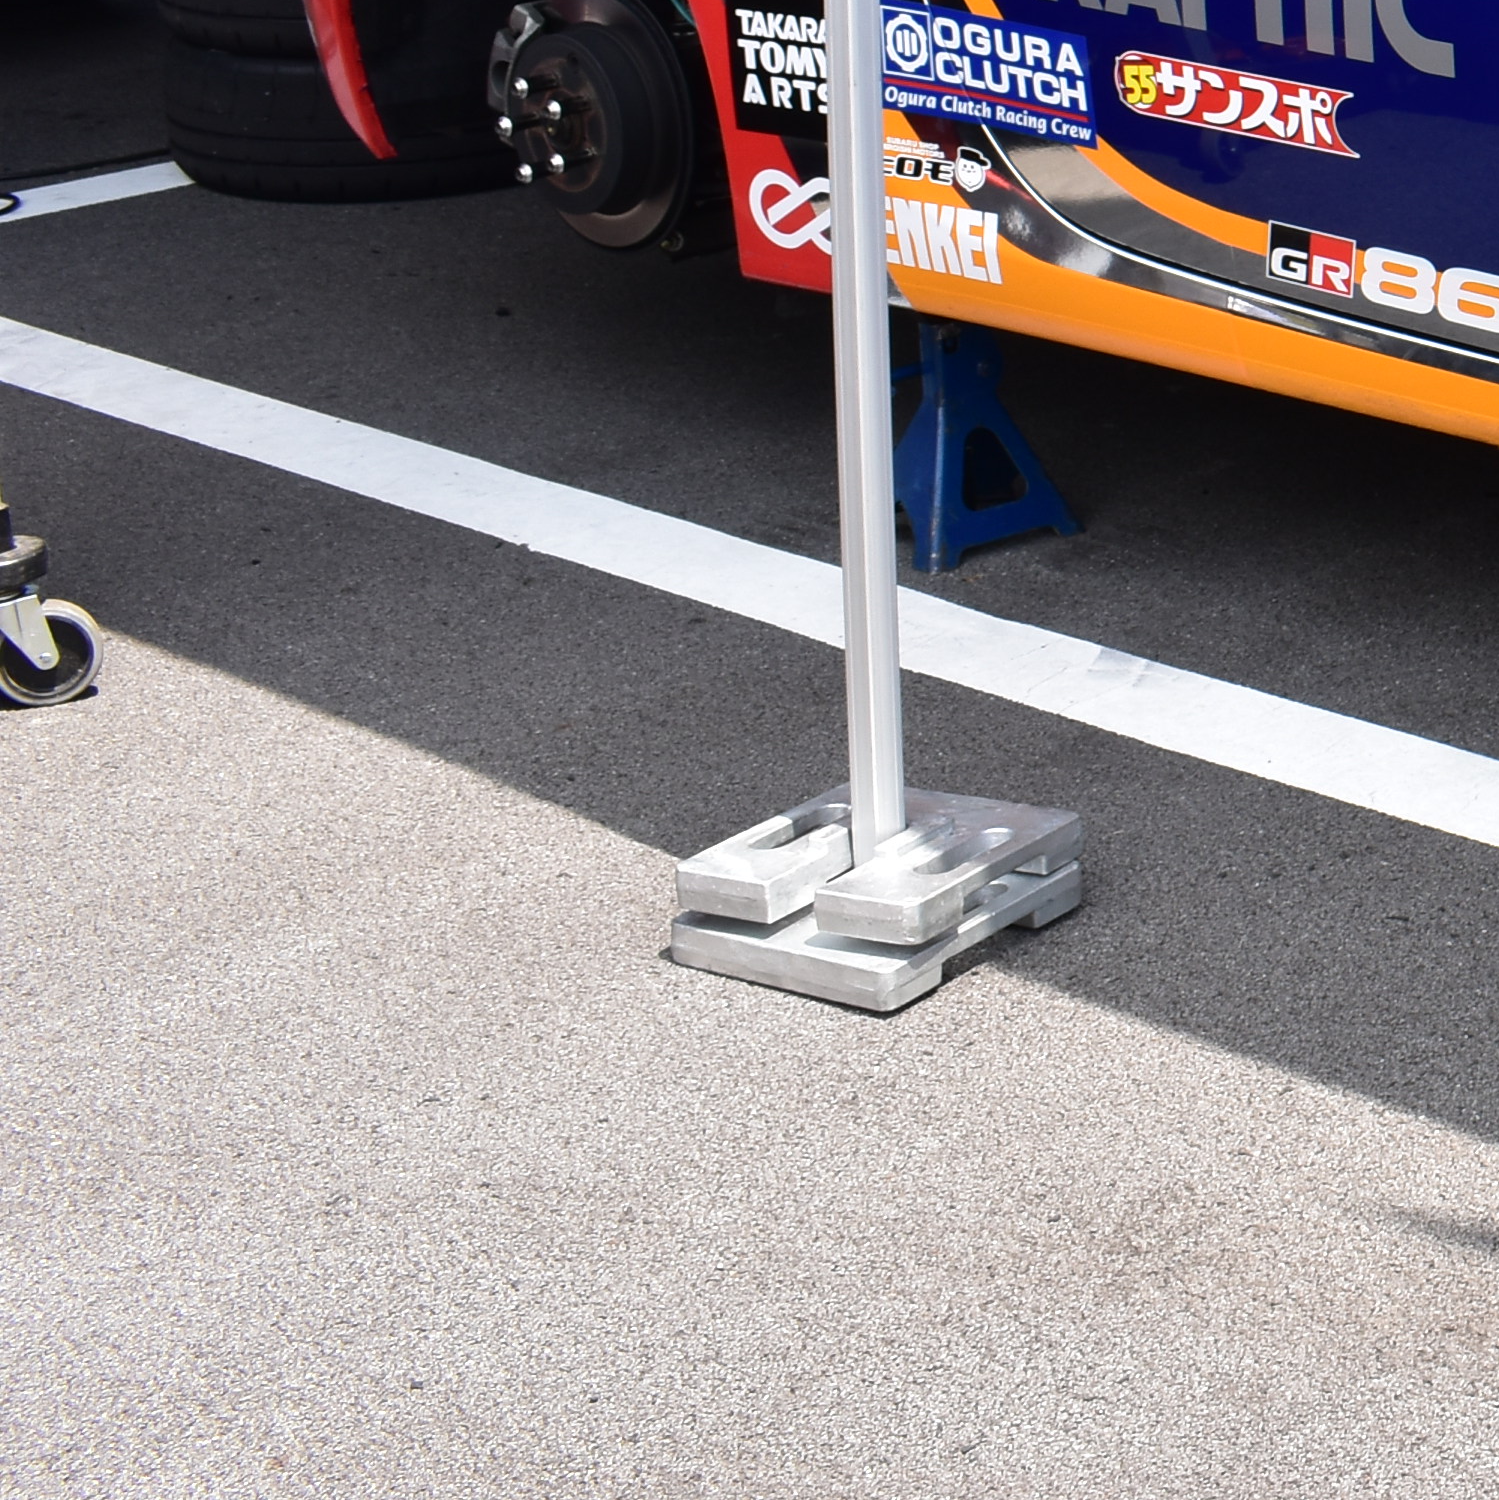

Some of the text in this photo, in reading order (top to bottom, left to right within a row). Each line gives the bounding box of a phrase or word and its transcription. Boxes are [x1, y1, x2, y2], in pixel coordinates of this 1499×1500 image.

[932, 16, 1083, 78] OGURA
[935, 52, 1088, 111] CLUTCH
[1154, 63, 1335, 145] サンスポ
[884, 85, 1092, 141] Ogura Clutch Racing Crew
[1271, 249, 1352, 296] GR
